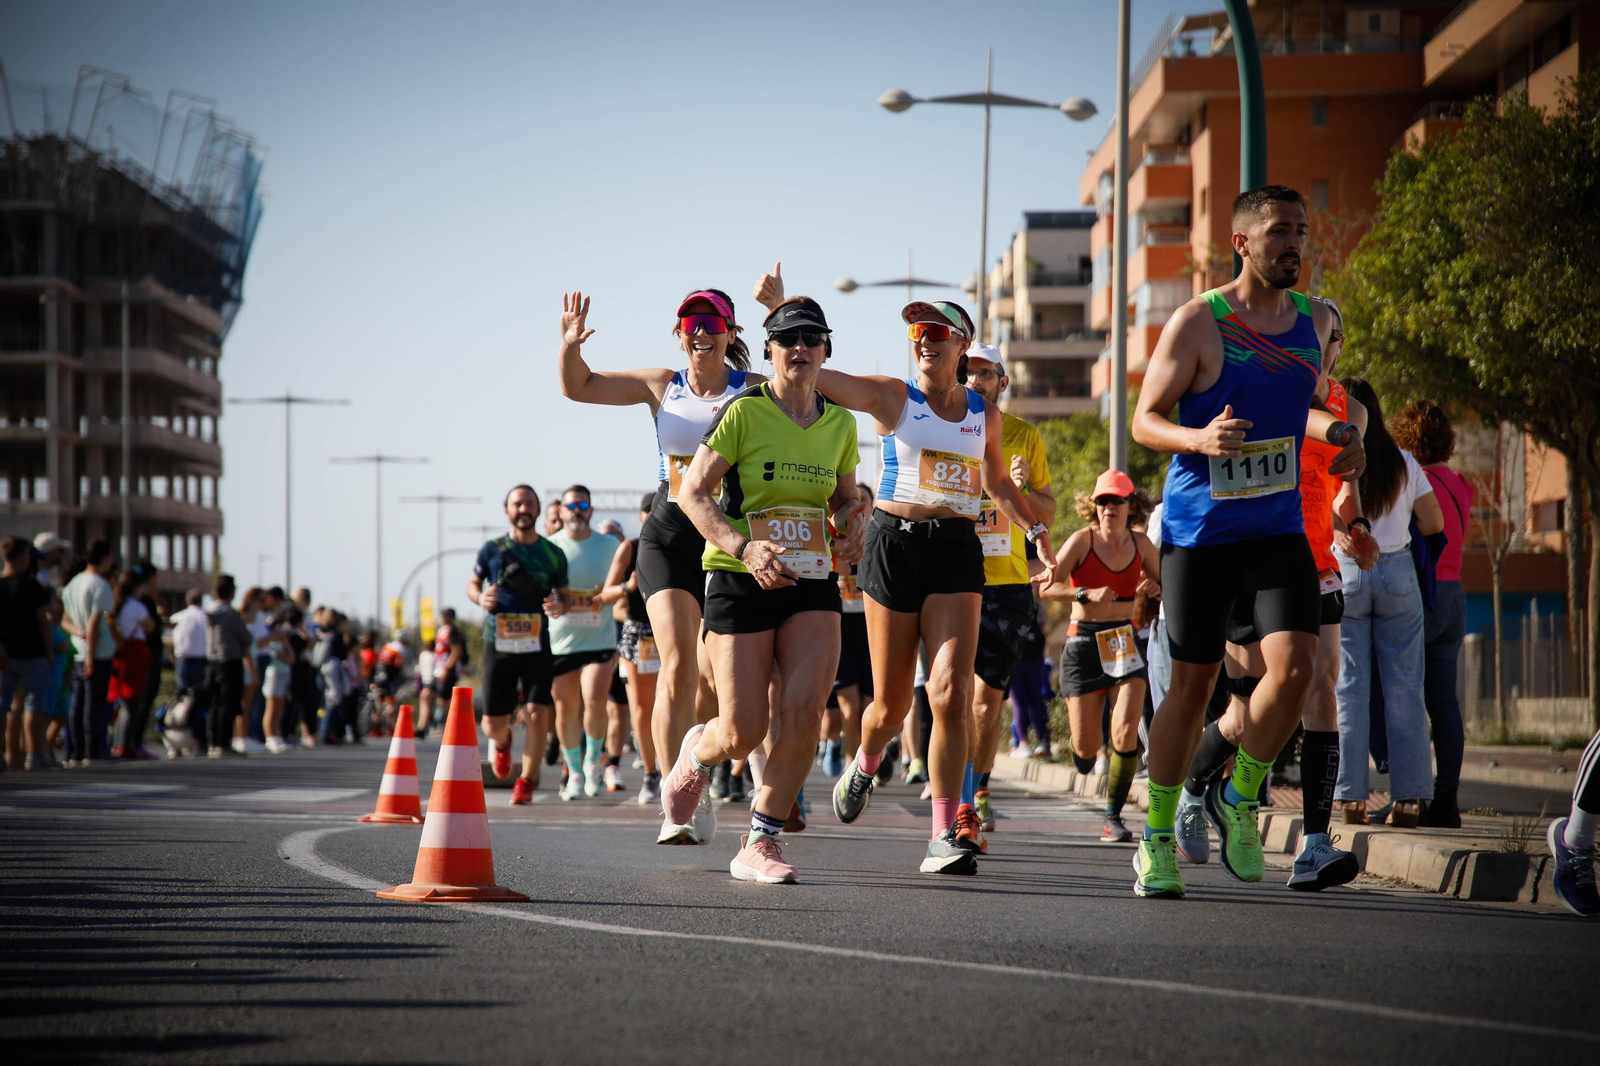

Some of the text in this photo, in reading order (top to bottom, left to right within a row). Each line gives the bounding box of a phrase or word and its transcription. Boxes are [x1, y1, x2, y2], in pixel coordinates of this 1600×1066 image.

[933, 462, 971, 486] 824
[1220, 452, 1287, 480] 1110
[1246, 479, 1265, 487] RAYA
[767, 519, 812, 542] 306
